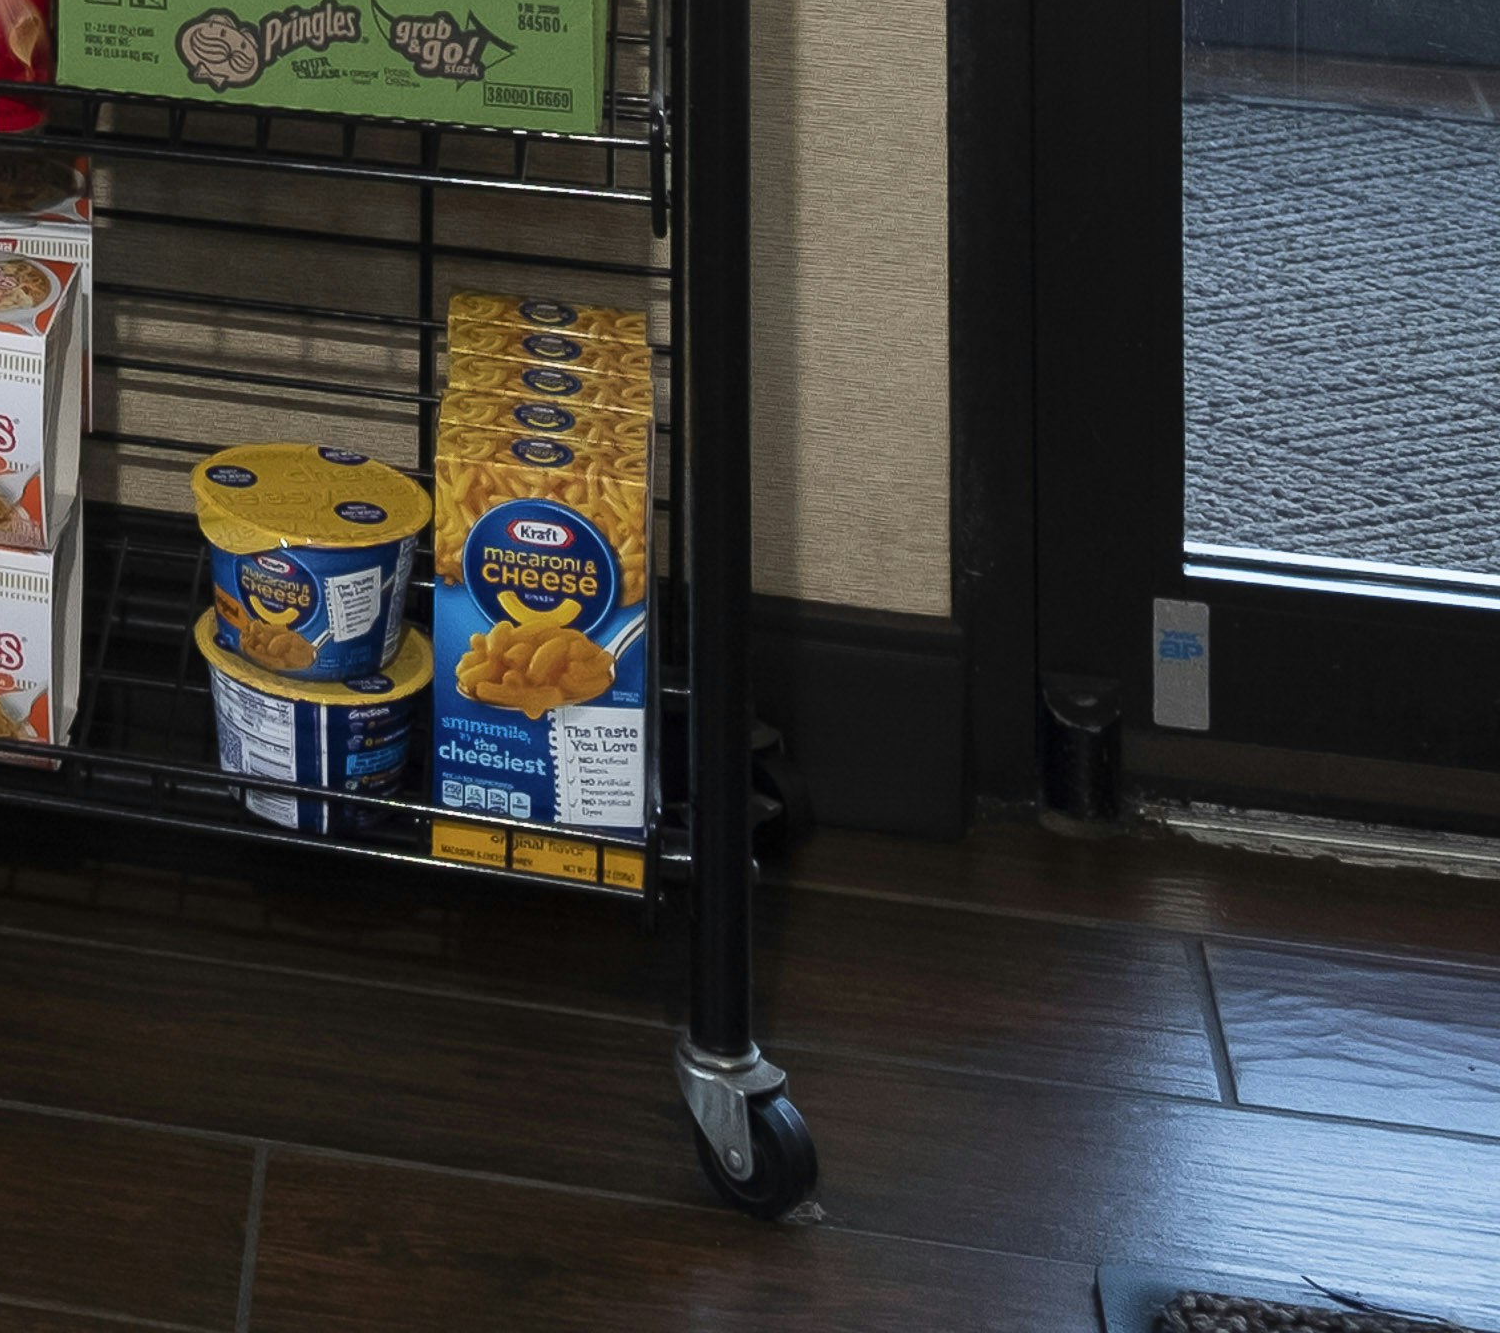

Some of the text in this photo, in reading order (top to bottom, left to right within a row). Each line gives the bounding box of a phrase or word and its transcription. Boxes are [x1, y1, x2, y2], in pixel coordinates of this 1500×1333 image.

[264, 3, 355, 61] Pringles
[396, 18, 452, 44] grab
[517, 16, 561, 33] 84560
[421, 37, 480, 69] go!
[519, 525, 559, 543] Kraft
[483, 545, 597, 574] macaroni &
[564, 726, 638, 739] The Taste
[474, 737, 497, 752] the
[571, 740, 638, 752] You Love
[439, 741, 546, 776] cheesiest
